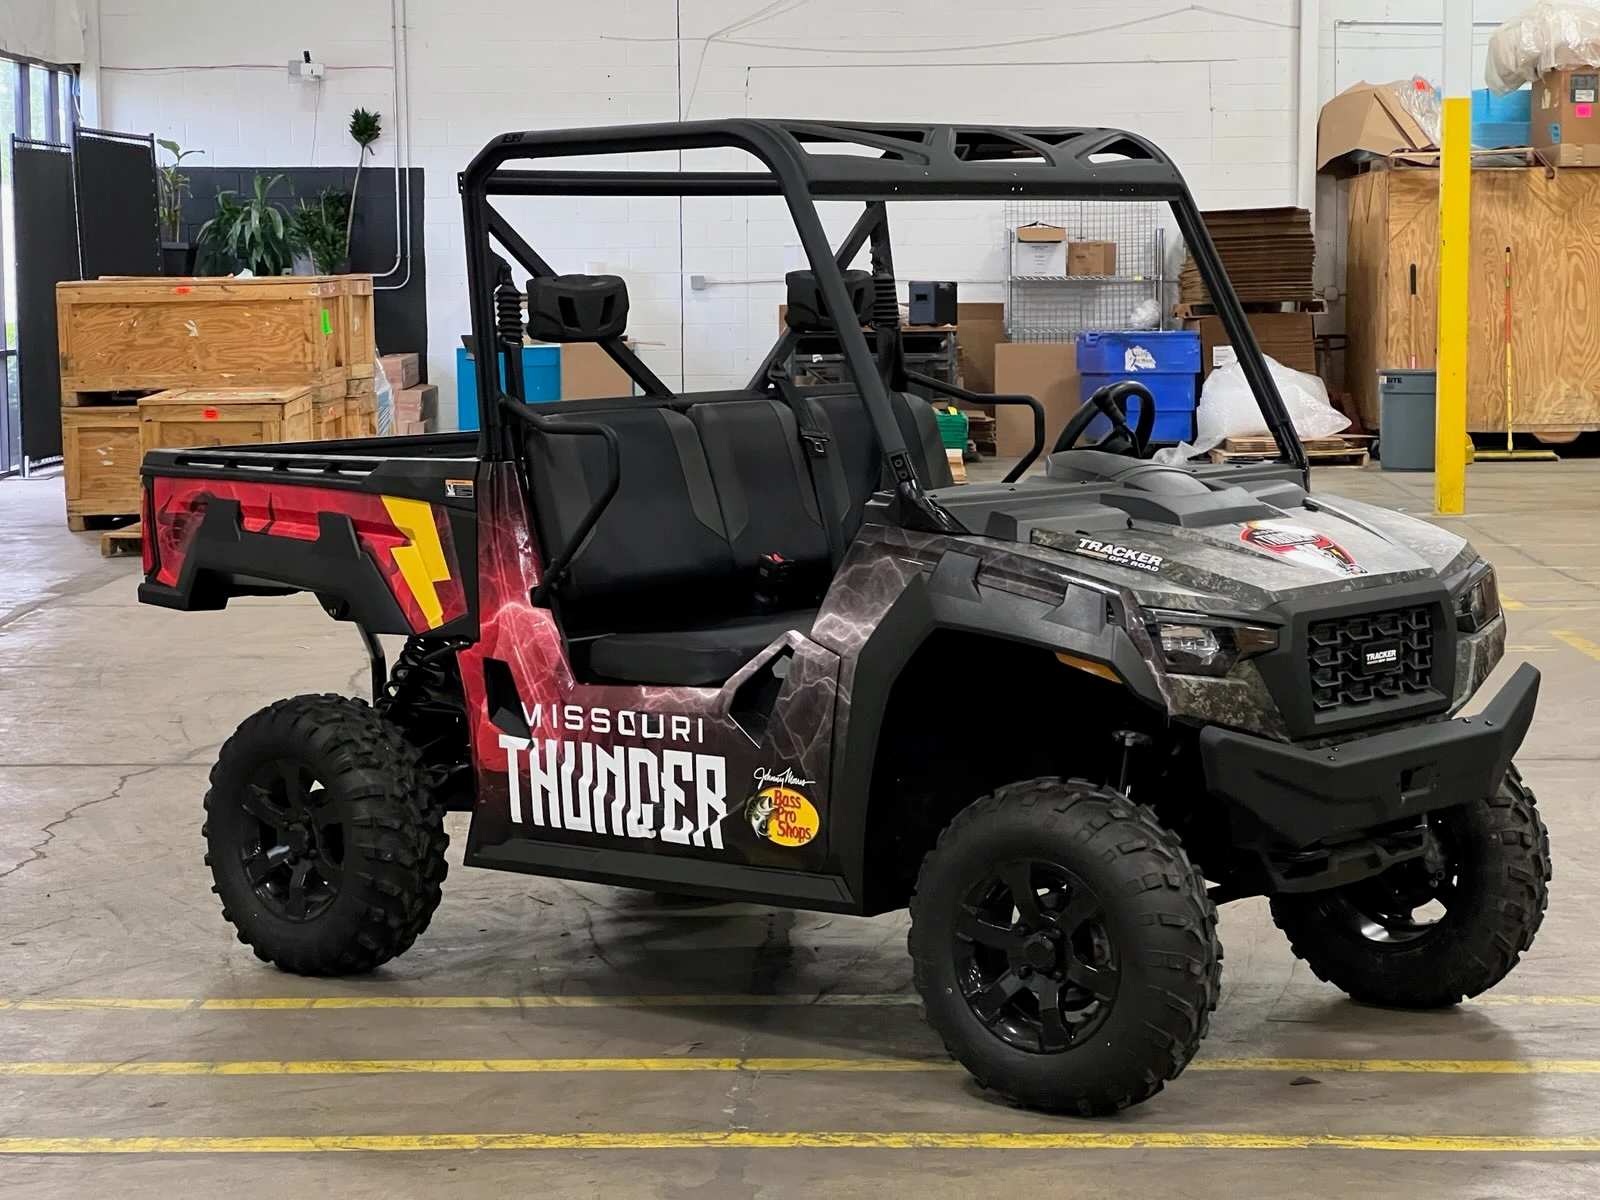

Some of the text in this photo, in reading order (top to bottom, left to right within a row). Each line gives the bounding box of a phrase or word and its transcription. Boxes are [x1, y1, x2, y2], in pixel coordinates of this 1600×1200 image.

[1079, 538, 1163, 565] TRACKER
[1108, 555, 1159, 572] OFF ROAD
[1366, 649, 1396, 660] TRACKER
[520, 702, 704, 743] MISSOURI
[498, 734, 729, 850] THUNDER
[773, 789, 802, 809] Bass
[775, 806, 797, 823] Pro
[776, 820, 812, 843] Shops
